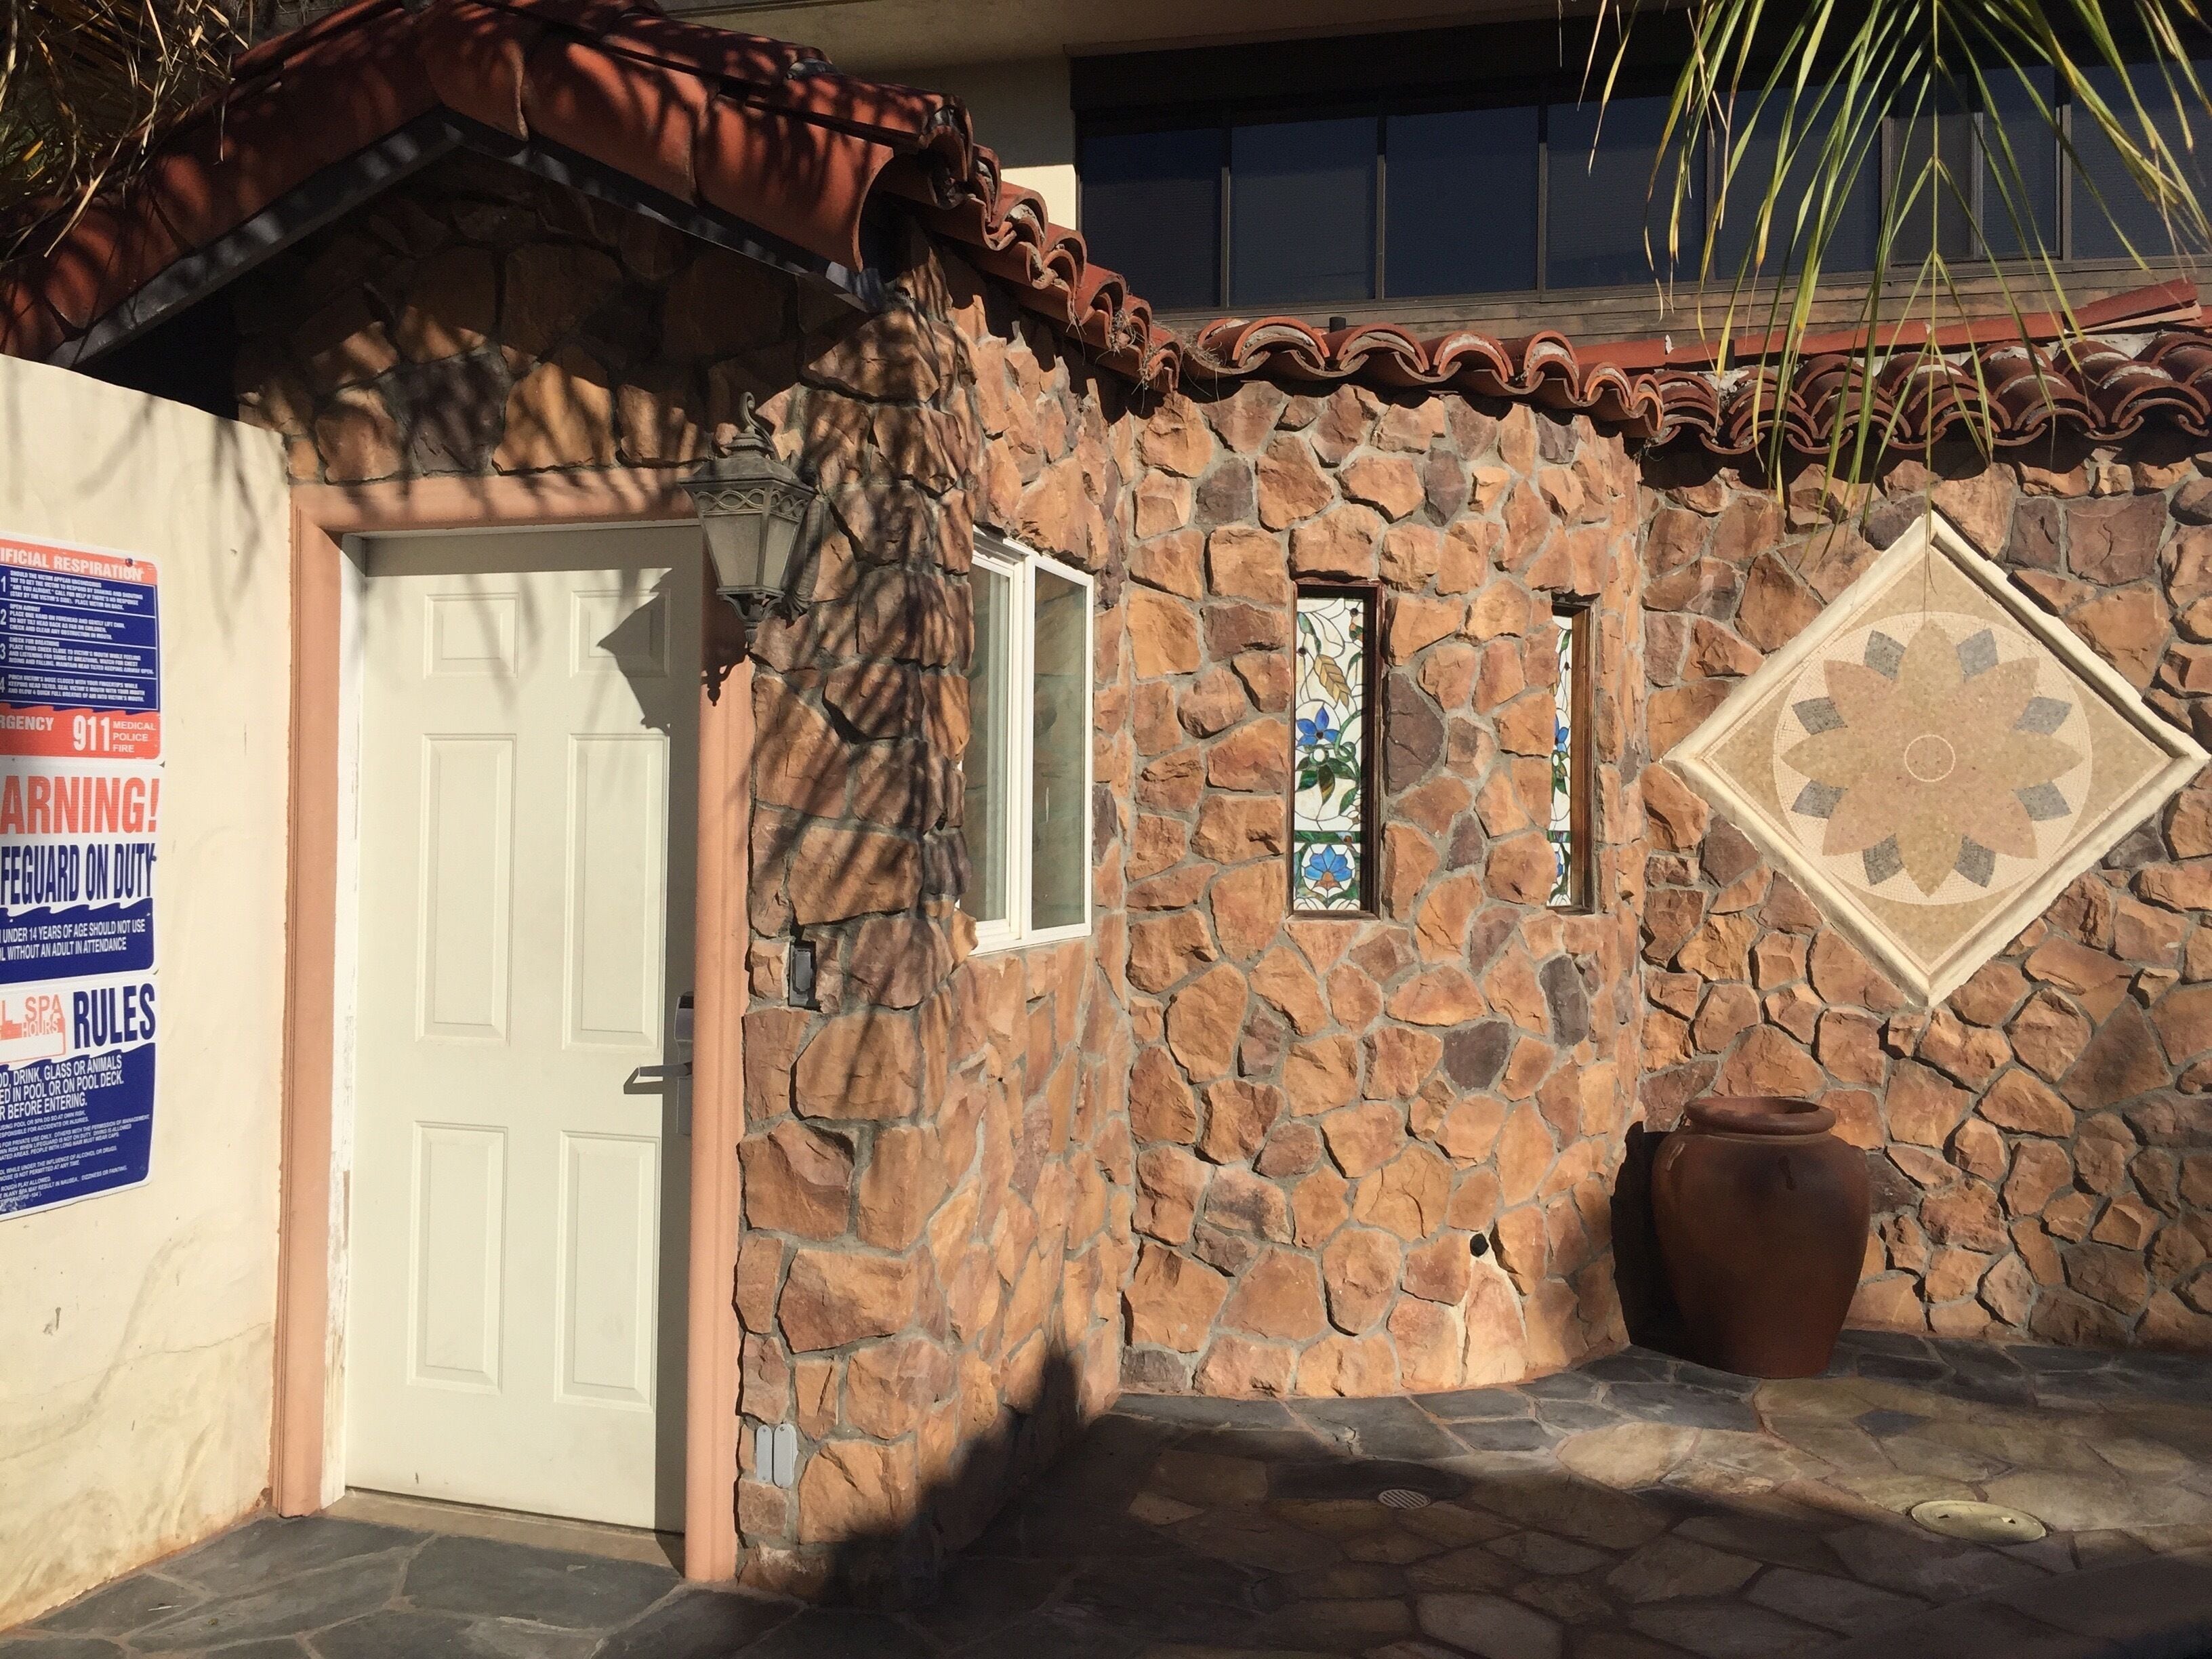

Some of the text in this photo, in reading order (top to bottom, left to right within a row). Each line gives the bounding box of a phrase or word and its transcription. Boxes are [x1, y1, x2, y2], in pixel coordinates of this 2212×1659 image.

[54, 556, 143, 581] RESPIRATION
[1, 575, 6, 592] 1
[0, 609, 6, 625] 2
[0, 643, 6, 659] 3
[0, 676, 5, 693] 4
[73, 715, 110, 751] 911
[113, 721, 157, 731] MEDICAL
[113, 733, 148, 741] POLICE
[113, 744, 135, 752] FIRE
[0, 775, 160, 834] ARNING!
[1, 842, 156, 905] FEGUARD ON DUTY
[3, 919, 146, 943] UNDER 14 YEARS OF AGE SHOULD NOT USE
[7, 937, 126, 960] WITHOUT AN ADULT IN ATTENDANCE
[25, 994, 64, 1021] SPA
[73, 983, 156, 1049] RULES
[22, 1019, 59, 1038] HOURS
[14, 1055, 122, 1086] DRINK, GLASS OR ANIMALS
[13, 1086, 21, 1102] IN
[24, 1082, 47, 1101] POOL
[49, 1080, 61, 1096] OR
[62, 1078, 75, 1094] ON
[77, 1074, 99, 1092] POOL
[100, 1070, 124, 1088] DECK.
[8, 1099, 42, 1119] BEFORE
[44, 1091, 87, 1113] ENTERING.
[37, 1122, 62, 1131] ACCIDENTS
[30, 1146, 48, 1155] PEOPLE
[34, 1139, 58, 1148] LIFEGUARD
[76, 1150, 96, 1160] ALCOHOL
